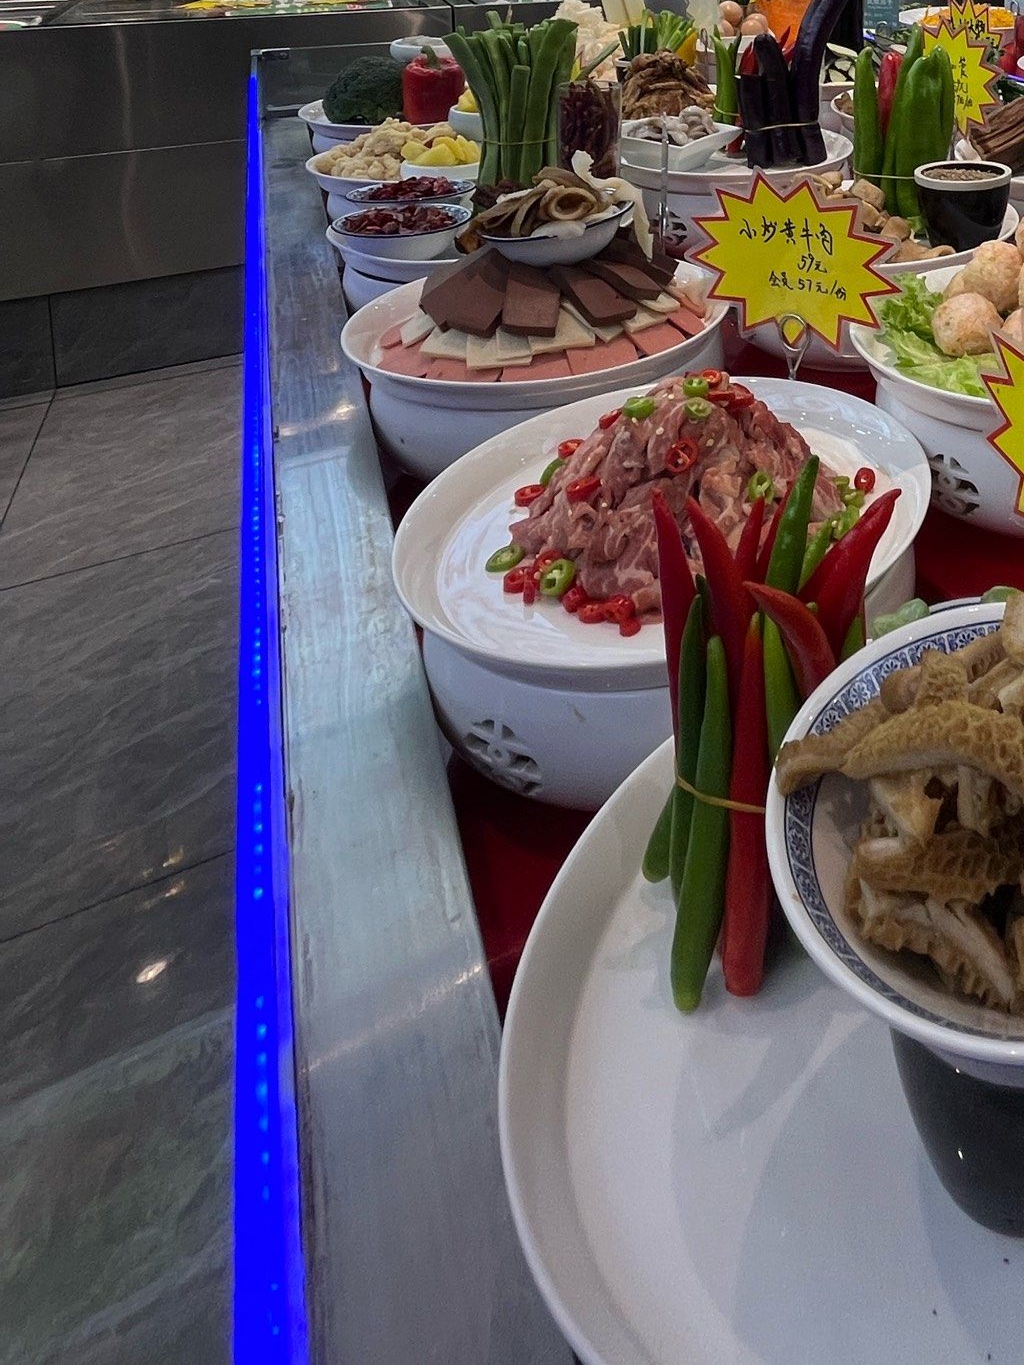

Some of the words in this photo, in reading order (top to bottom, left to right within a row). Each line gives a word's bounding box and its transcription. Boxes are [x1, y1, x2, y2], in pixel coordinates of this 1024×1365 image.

[739, 215, 833, 256] 小炒黄牛肉
[797, 253, 828, 274] 59元
[768, 271, 794, 291] 会员
